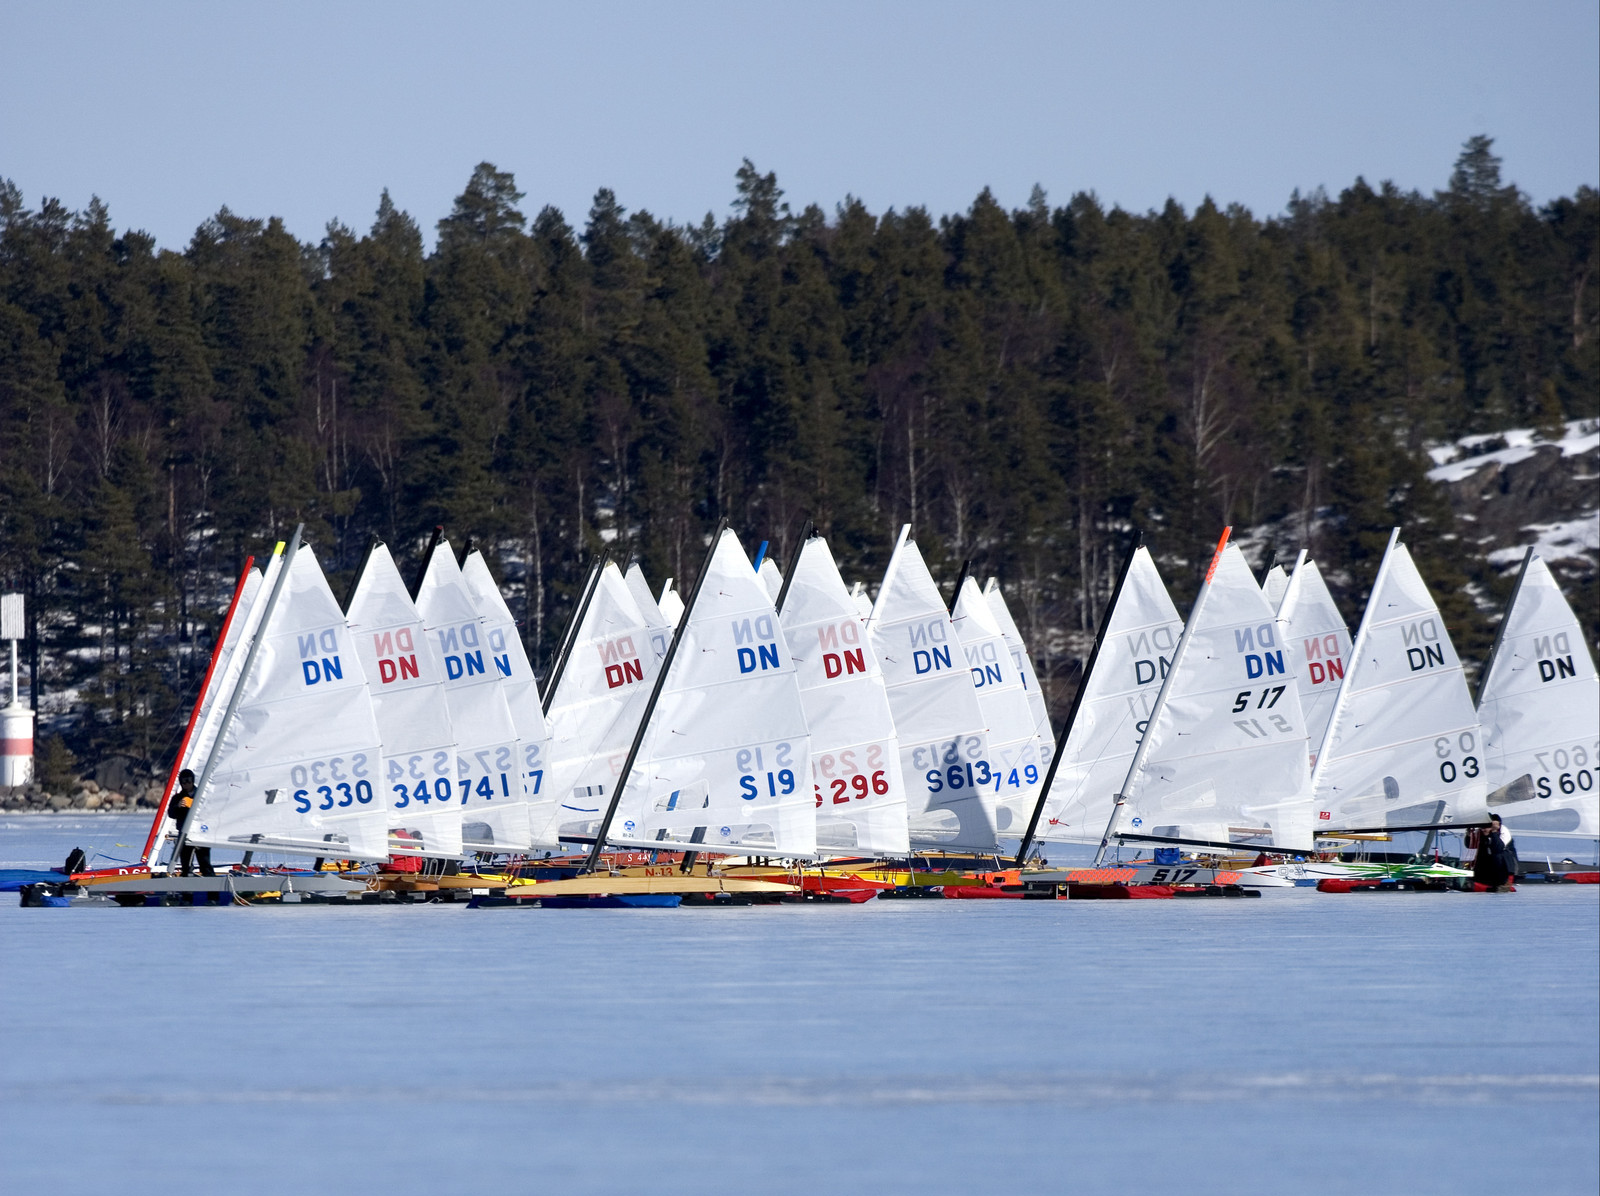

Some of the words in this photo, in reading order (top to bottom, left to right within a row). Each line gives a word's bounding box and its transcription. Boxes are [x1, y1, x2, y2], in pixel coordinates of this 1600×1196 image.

[302, 655, 343, 685] DN
[378, 654, 420, 684] DN
[444, 650, 485, 681] DN
[737, 643, 781, 674] DN
[823, 648, 866, 679] DN
[913, 645, 952, 675] DN
[1245, 650, 1285, 680] DN
[1308, 658, 1344, 685] DN
[1406, 643, 1445, 672] DN
[1538, 655, 1576, 683] DN
[605, 658, 644, 689] DN
[972, 663, 1002, 688] DN
[1257, 685, 1286, 709] 17
[522, 769, 544, 795] 7
[926, 760, 992, 793] S613
[993, 764, 1039, 793] 749
[392, 777, 451, 809] 340
[1171, 869, 1197, 882] 17
